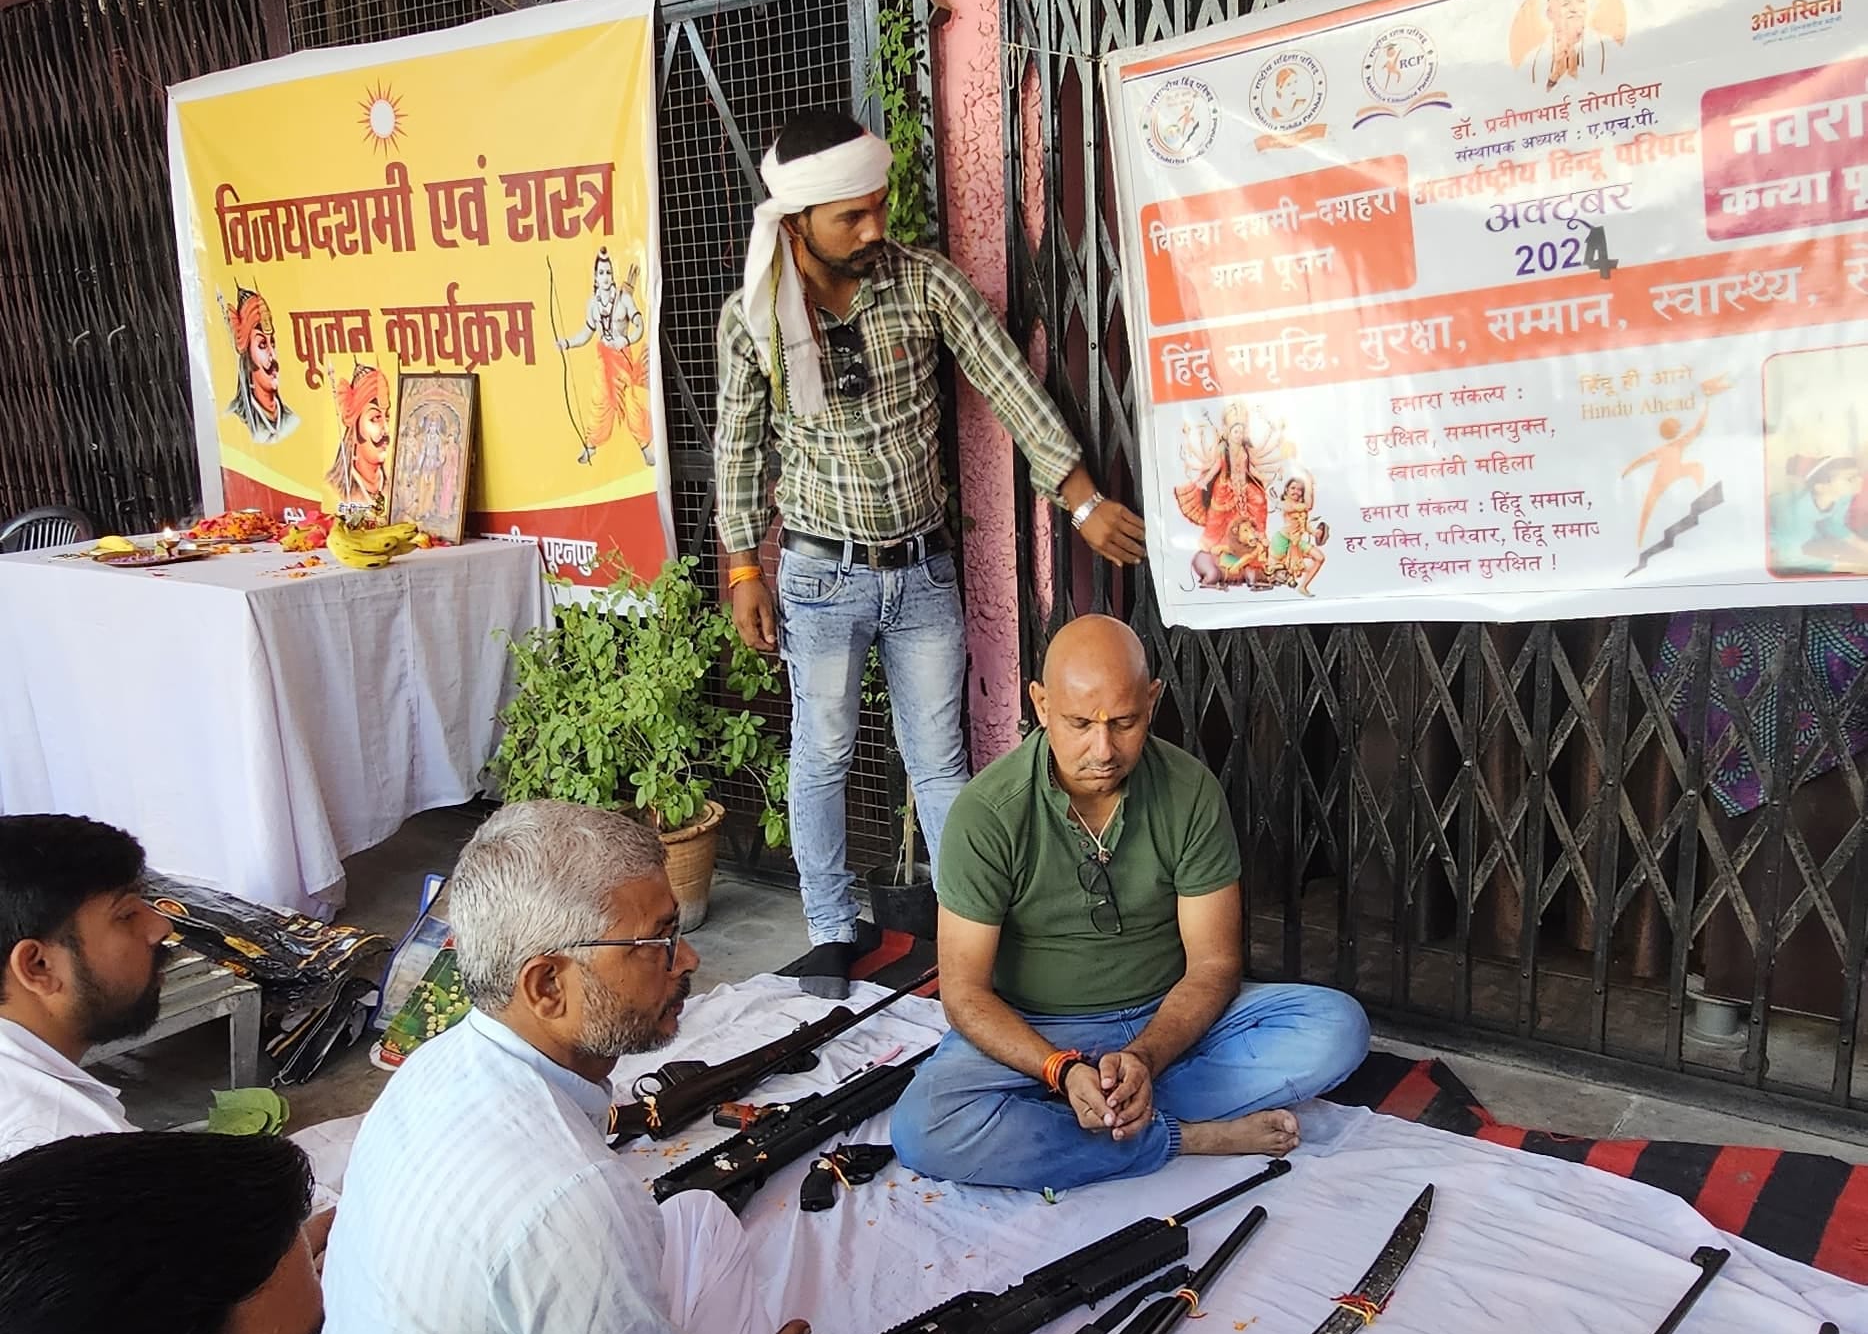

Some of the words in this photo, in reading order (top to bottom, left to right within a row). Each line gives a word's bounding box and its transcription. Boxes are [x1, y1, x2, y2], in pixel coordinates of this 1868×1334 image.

[1451, 117, 1476, 140] डॉ.
[1485, 95, 1571, 133] प्रवीणभाई
[1578, 83, 1662, 114] तोगड़िया
[1730, 80, 1868, 155] नवरा
[1455, 138, 1515, 163] संस्थापक
[1522, 130, 1567, 151] अध्यक्ष
[1587, 108, 1659, 138] ए.एच.पी.
[215, 162, 415, 266] विजयदशमी
[425, 155, 490, 248] एवं
[499, 161, 616, 242] शस्त्र
[1485, 182, 1633, 233] अक्टूबर
[1719, 170, 1831, 216] कन्या
[1149, 220, 1221, 256] विजया
[1515, 226, 1619, 280] 2024
[1210, 259, 1264, 289] शस्त्र
[1272, 247, 1334, 291] पूजन
[381, 282, 536, 374] कार्यक्रम
[1161, 342, 1221, 392] हिंदू
[1358, 315, 1466, 370] सुरक्षा,
[1485, 294, 1628, 343] सम्मान,
[1650, 267, 1817, 319] स्वास्थ्य,
[1391, 392, 1443, 415] हमारा
[1450, 384, 1506, 407] संकल्प
[1581, 401, 1633, 421] Hindu
[1475, 451, 1535, 475] महिला
[1360, 503, 1409, 523] हमारा
[1417, 498, 1469, 518] संकल्प
[1491, 491, 1525, 517] हिंदू
[1530, 490, 1593, 512] समाज,
[1344, 536, 1367, 554] हर
[1436, 524, 1506, 547] परिवार,
[1513, 520, 1548, 547] हिंदू
[1400, 556, 1471, 583] हिंदूस्थान
[1478, 550, 1543, 579] सुरक्षित
